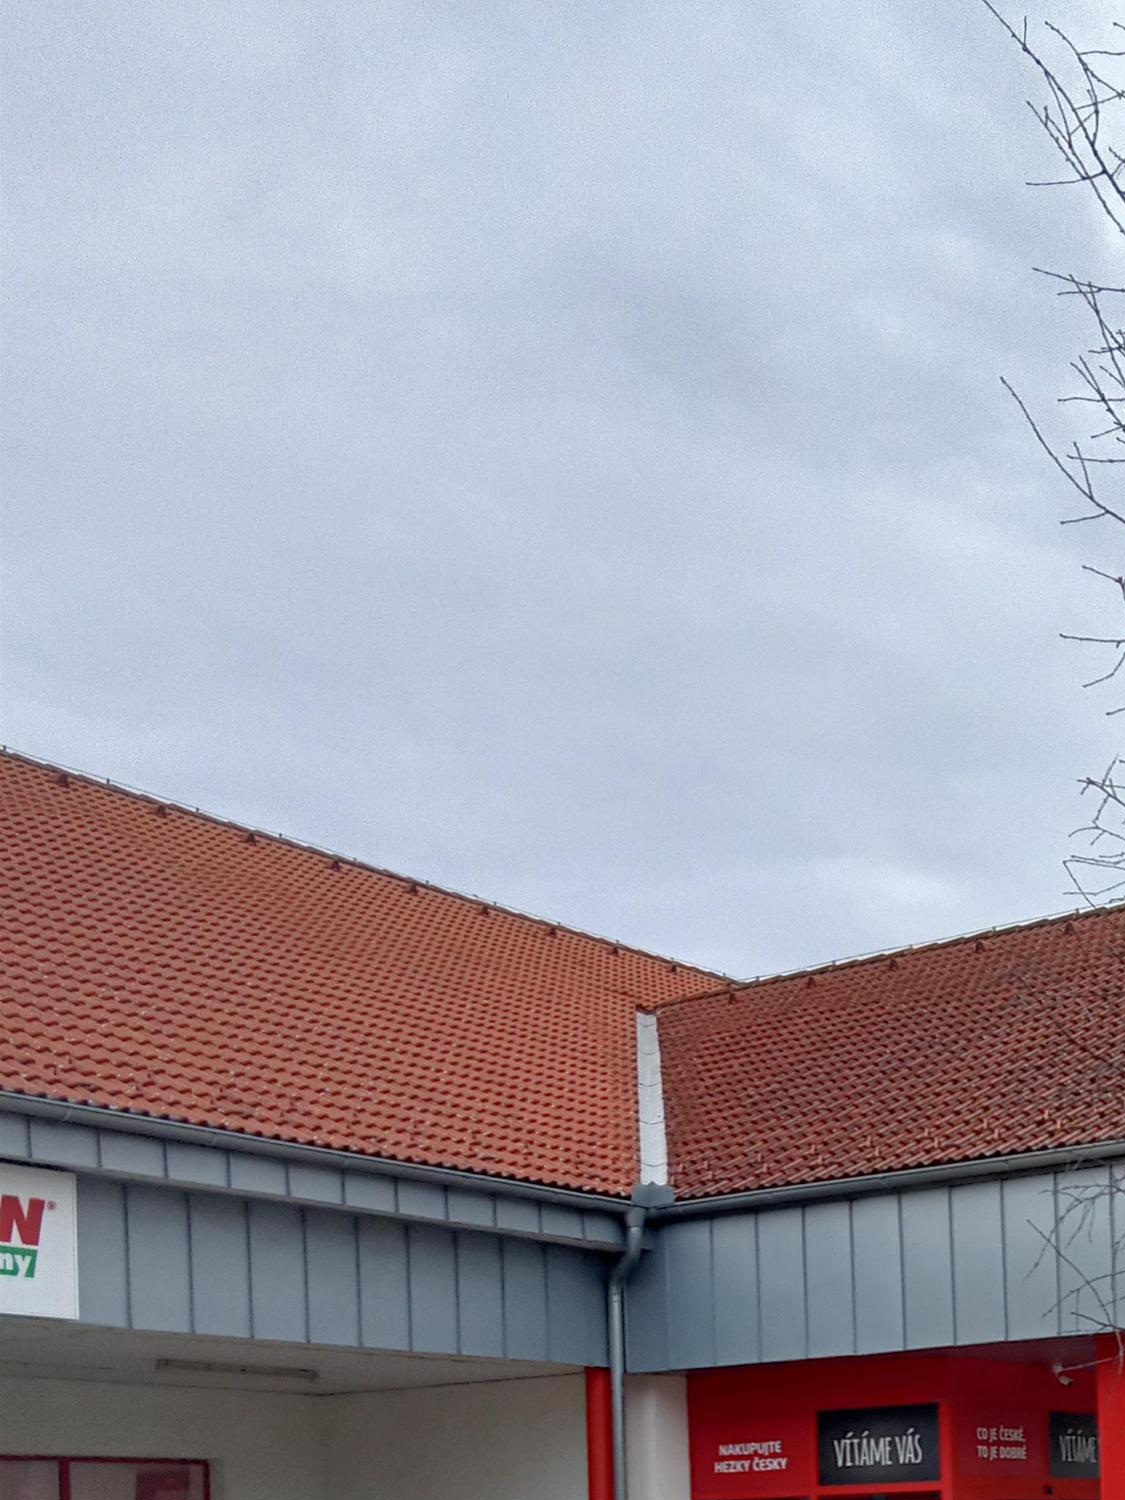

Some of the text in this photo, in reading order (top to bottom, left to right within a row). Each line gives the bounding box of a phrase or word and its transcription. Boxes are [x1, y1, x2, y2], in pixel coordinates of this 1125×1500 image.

[719, 1441, 782, 1456] NAKUPUJTE
[833, 1427, 923, 1467] VÍTÁME VÁS
[714, 1457, 788, 1473] HEZKY ČESKY
